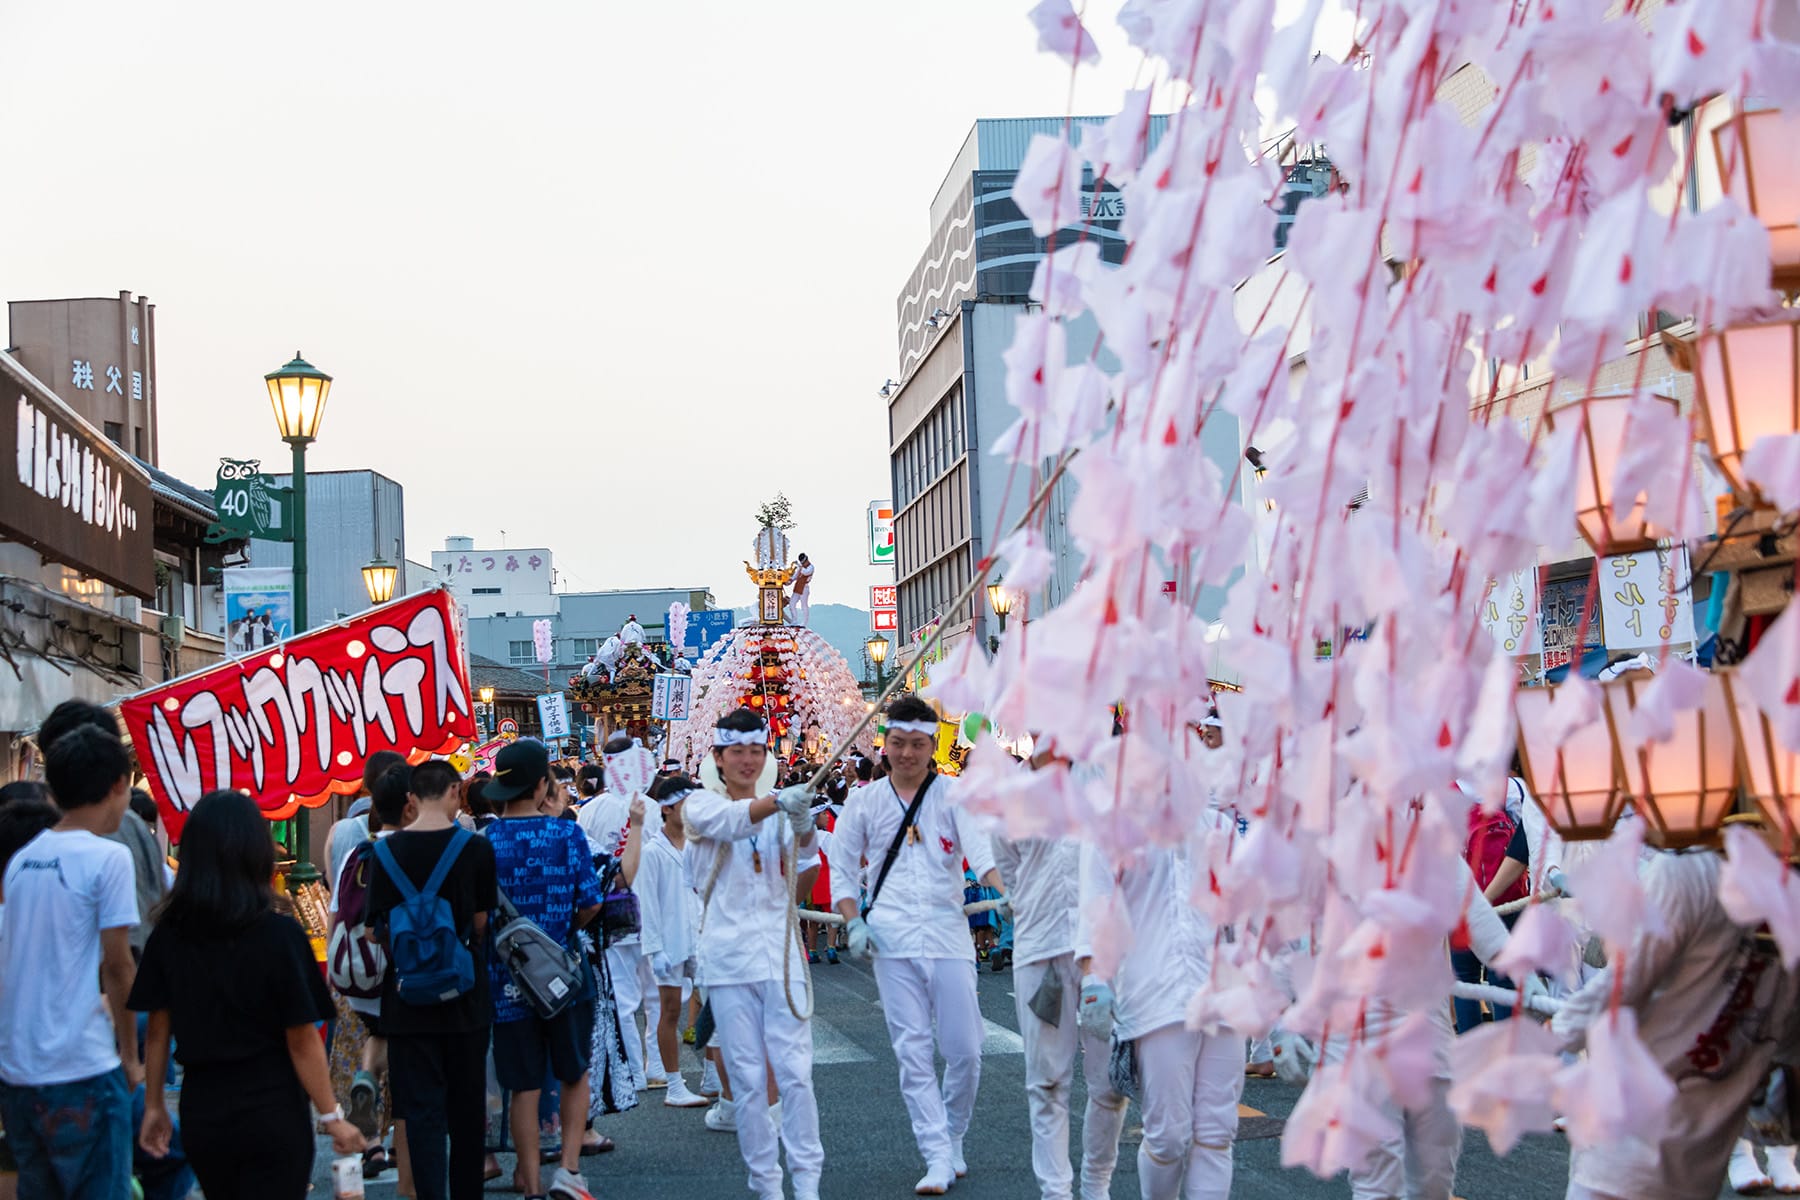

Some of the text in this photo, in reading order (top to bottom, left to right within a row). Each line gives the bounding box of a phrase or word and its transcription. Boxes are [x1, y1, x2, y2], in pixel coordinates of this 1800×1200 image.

[220, 489, 249, 517] 40
[457, 554, 542, 573] たつみや
[671, 680, 684, 718] 川瀬祭
[503, 723, 514, 732] 40
[516, 831, 536, 840] UNA
